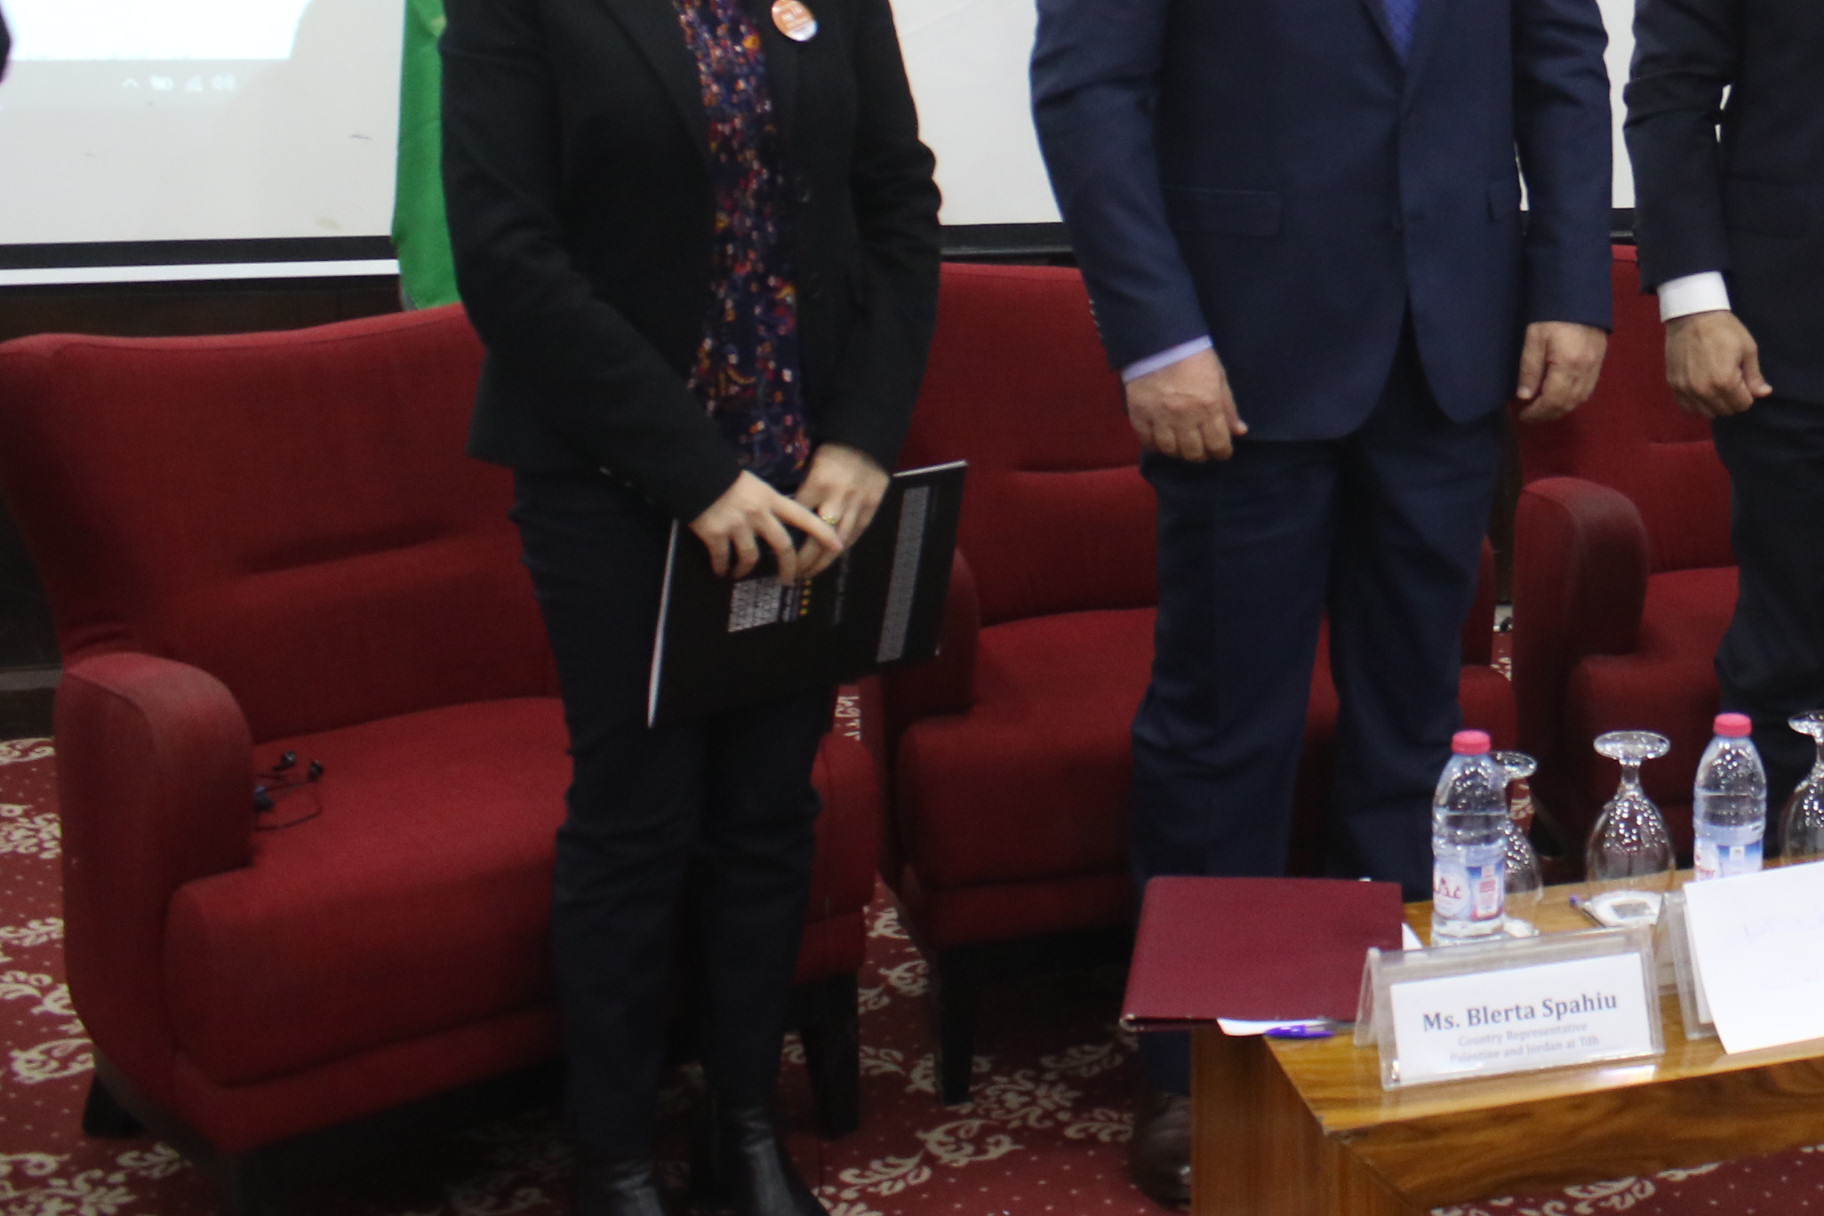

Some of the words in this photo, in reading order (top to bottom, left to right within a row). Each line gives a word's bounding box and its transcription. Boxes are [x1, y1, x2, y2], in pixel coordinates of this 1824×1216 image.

[1422, 1012, 1461, 1032] Ms.
[1467, 1003, 1536, 1027] Blerta
[1541, 992, 1618, 1021] Spahiu
